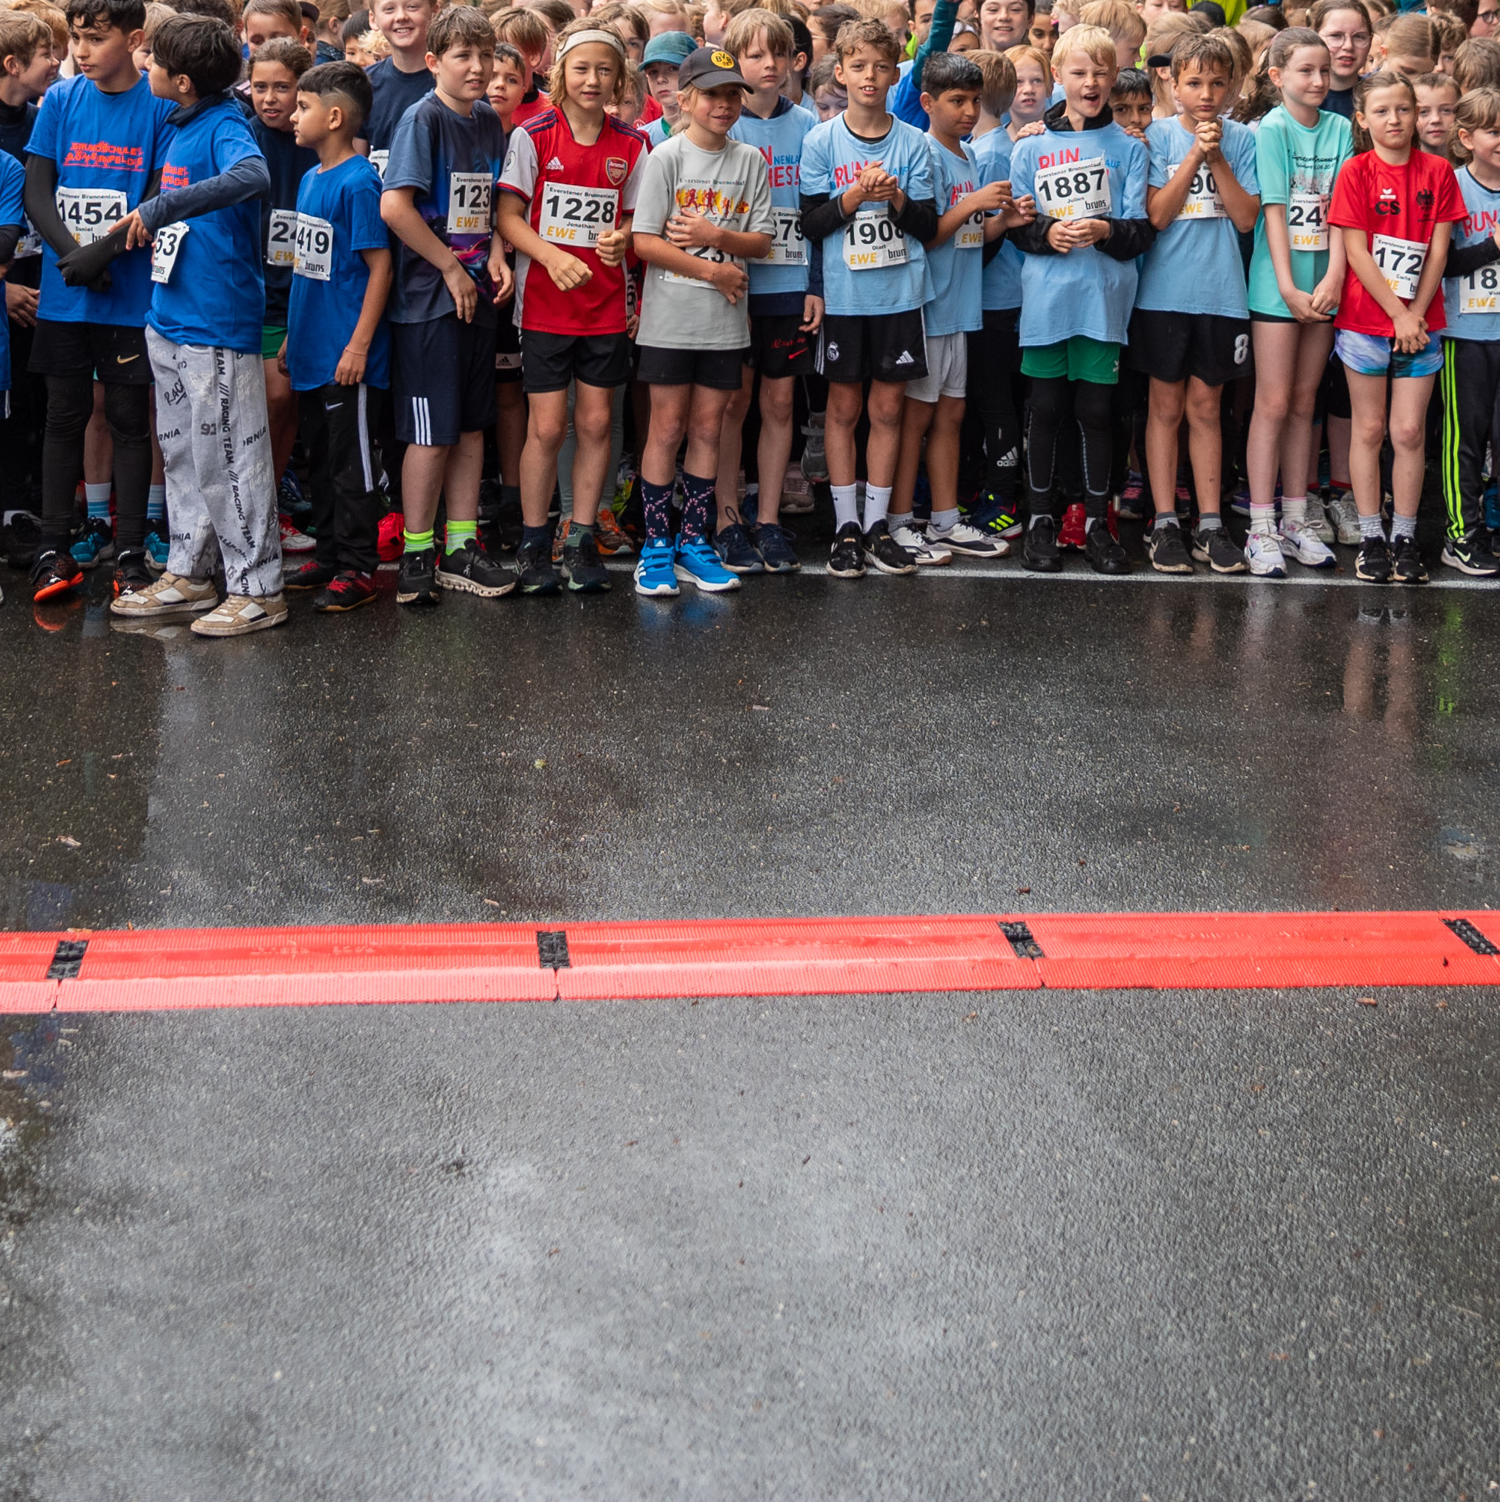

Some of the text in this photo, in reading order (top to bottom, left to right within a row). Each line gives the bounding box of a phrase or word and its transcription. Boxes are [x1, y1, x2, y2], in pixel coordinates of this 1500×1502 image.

[1038, 168, 1105, 202] 1887
[57, 199, 125, 226] 1454
[546, 195, 615, 224] 1228
[1085, 199, 1107, 211] bruns
[1374, 200, 1402, 216] CS
[455, 216, 479, 228] EWE
[546, 225, 577, 240] EWE
[1292, 234, 1321, 246] EWE
[850, 252, 877, 265] EWE
[1467, 297, 1497, 308] EWE
[1233, 333, 1249, 365] 8
